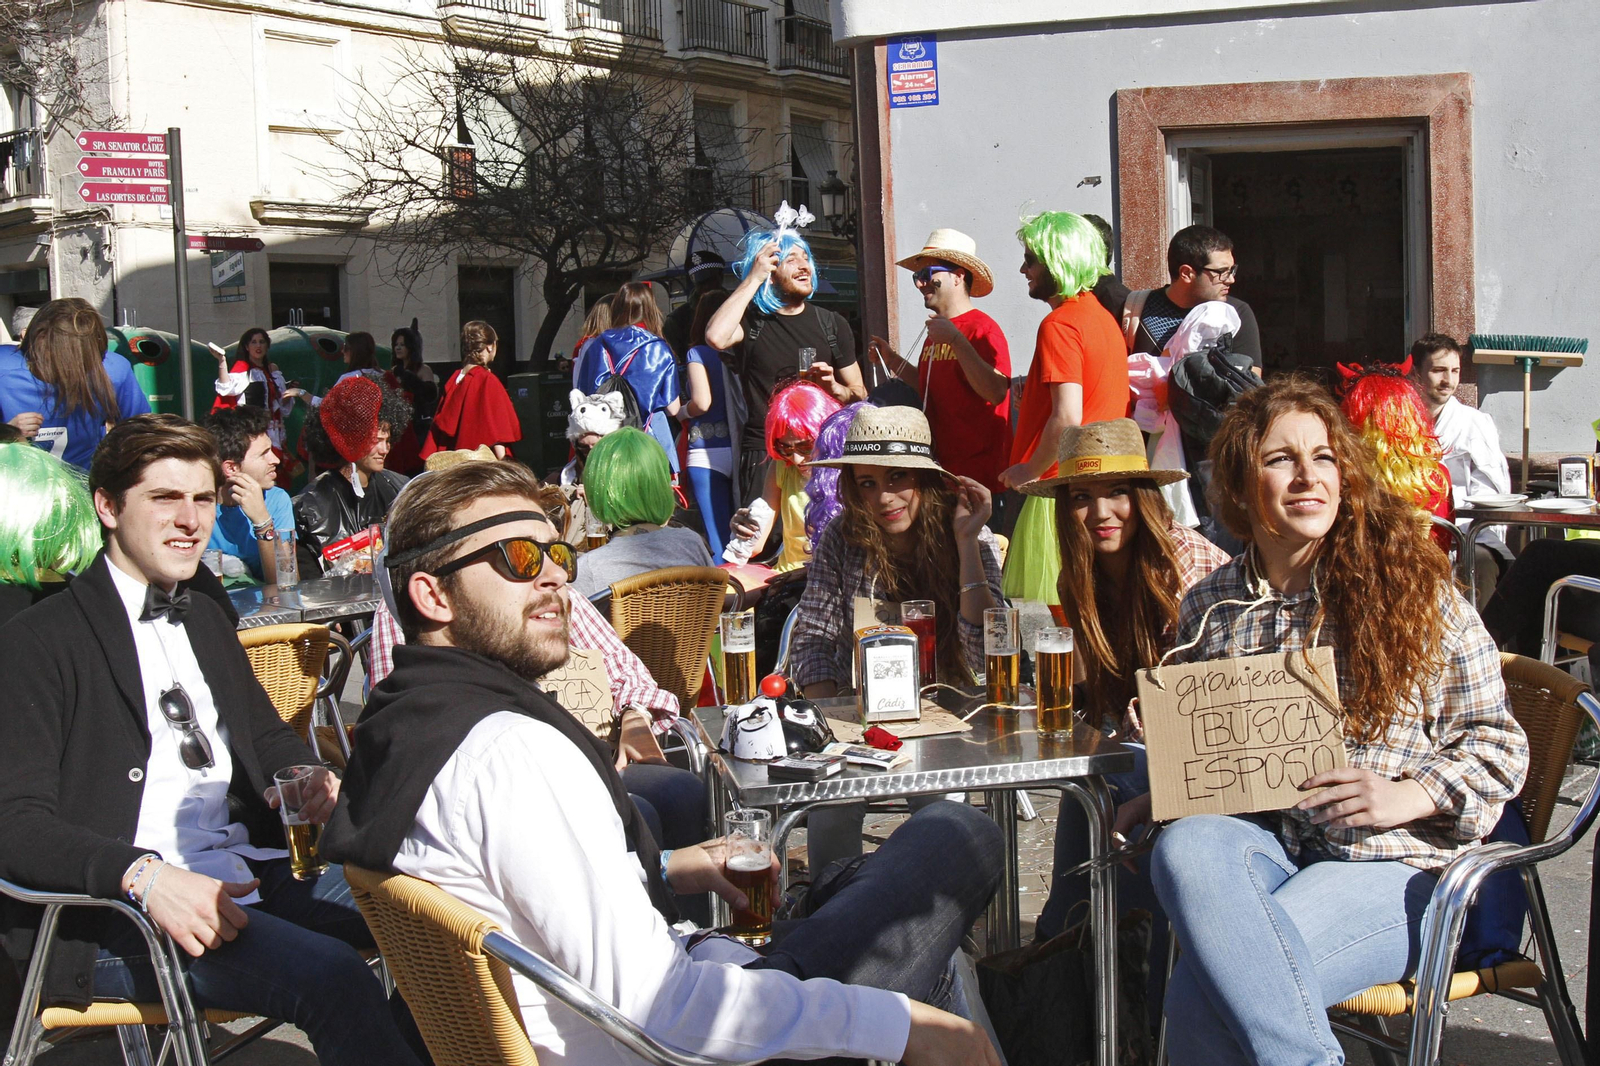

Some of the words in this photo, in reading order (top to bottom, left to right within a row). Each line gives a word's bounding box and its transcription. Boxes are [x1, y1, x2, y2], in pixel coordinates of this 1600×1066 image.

[899, 73, 928, 81] Alarma
[92, 140, 107, 150] SPA
[108, 141, 141, 151] SENATOR
[142, 139, 164, 152] CÁDIZ
[102, 166, 137, 176] FRANCIA
[136, 167, 142, 176] Y
[143, 166, 165, 177] PARÍS
[96, 192, 110, 201] LAS
[110, 193, 136, 202] CORTES
[136, 193, 146, 202] DE
[146, 192, 167, 202] CÁDIZ
[850, 443, 881, 452] BAVARO
[1175, 665, 1300, 716] granjera
[877, 697, 906, 711] Cádiz
[1197, 700, 1322, 747] BUSCA
[1184, 744, 1335, 800] ESPOSO
